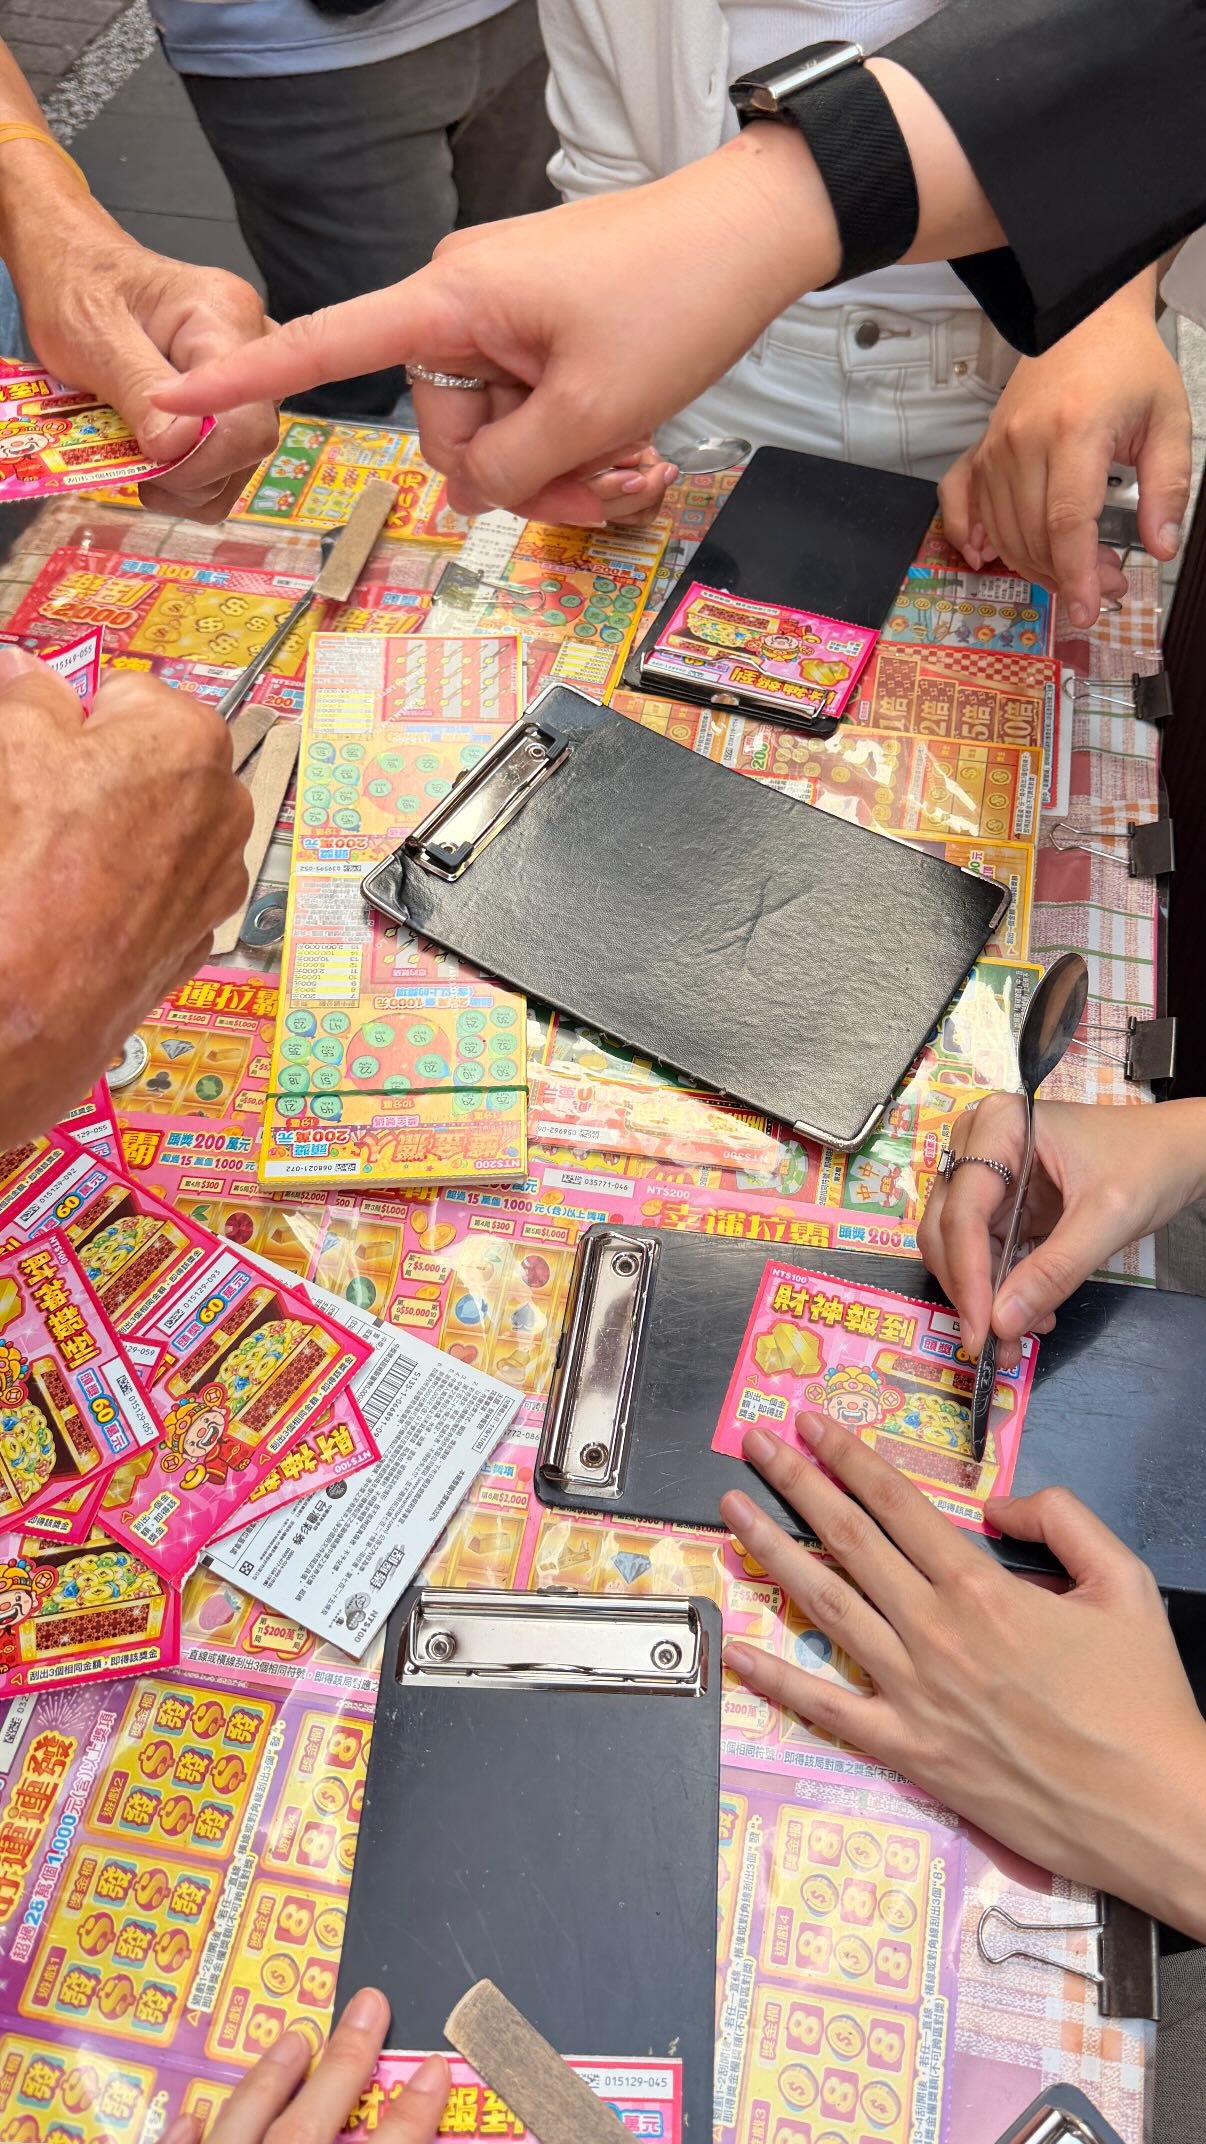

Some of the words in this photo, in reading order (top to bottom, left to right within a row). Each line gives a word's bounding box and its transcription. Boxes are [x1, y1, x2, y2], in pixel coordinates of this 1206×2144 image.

[167, 1131, 251, 1152] 頭獎200萬元
[276, 1130, 347, 1143] 200萬元
[293, 1144, 327, 1154] 頭獎
[475, 1159, 519, 1167] NT$200
[39, 1165, 77, 1205] 015129-092
[584, 1178, 629, 1191] 035771-046
[646, 1186, 691, 1200] NT$200
[381, 1203, 406, 1216] $1,000
[492, 1220, 511, 1232] $300
[47, 1234, 69, 1266] NT$100
[541, 1227, 567, 1240] $1,000
[182, 1267, 221, 1311] 015129-093
[772, 1268, 808, 1284] NT$100
[15, 1247, 102, 1371] 財神報到
[171, 1265, 251, 1354] 頭獎60萬元
[400, 1305, 430, 1318] $50,000
[773, 1283, 917, 1348] 財神報到
[74, 1367, 132, 1453] 頭獎60萬元
[126, 1394, 153, 1437] 015129-057
[333, 1449, 373, 1475] NT$100
[499, 1491, 527, 1505] $2,000
[290, 1497, 327, 1547] 台灣彩券
[353, 1609, 378, 1643] NT$100
[28, 1645, 158, 1682] 刮出3個相同金額，即得該獎金
[101, 1774, 125, 1818] 遊戲2
[130, 1691, 156, 1737] 獎金欄
[299, 1725, 325, 1772] 獎金欄
[782, 1821, 803, 1870] 獎金欄
[37, 1954, 61, 1999] 遊戲1
[67, 1859, 96, 1910] 獎金欄
[772, 1913, 793, 1958] 遊戲4
[221, 1992, 246, 2040] 遊戲3
[245, 1896, 275, 1950] 獎金欄
[759, 2003, 783, 2059] 獎金欄
[603, 2075, 668, 2088] 015129-045
